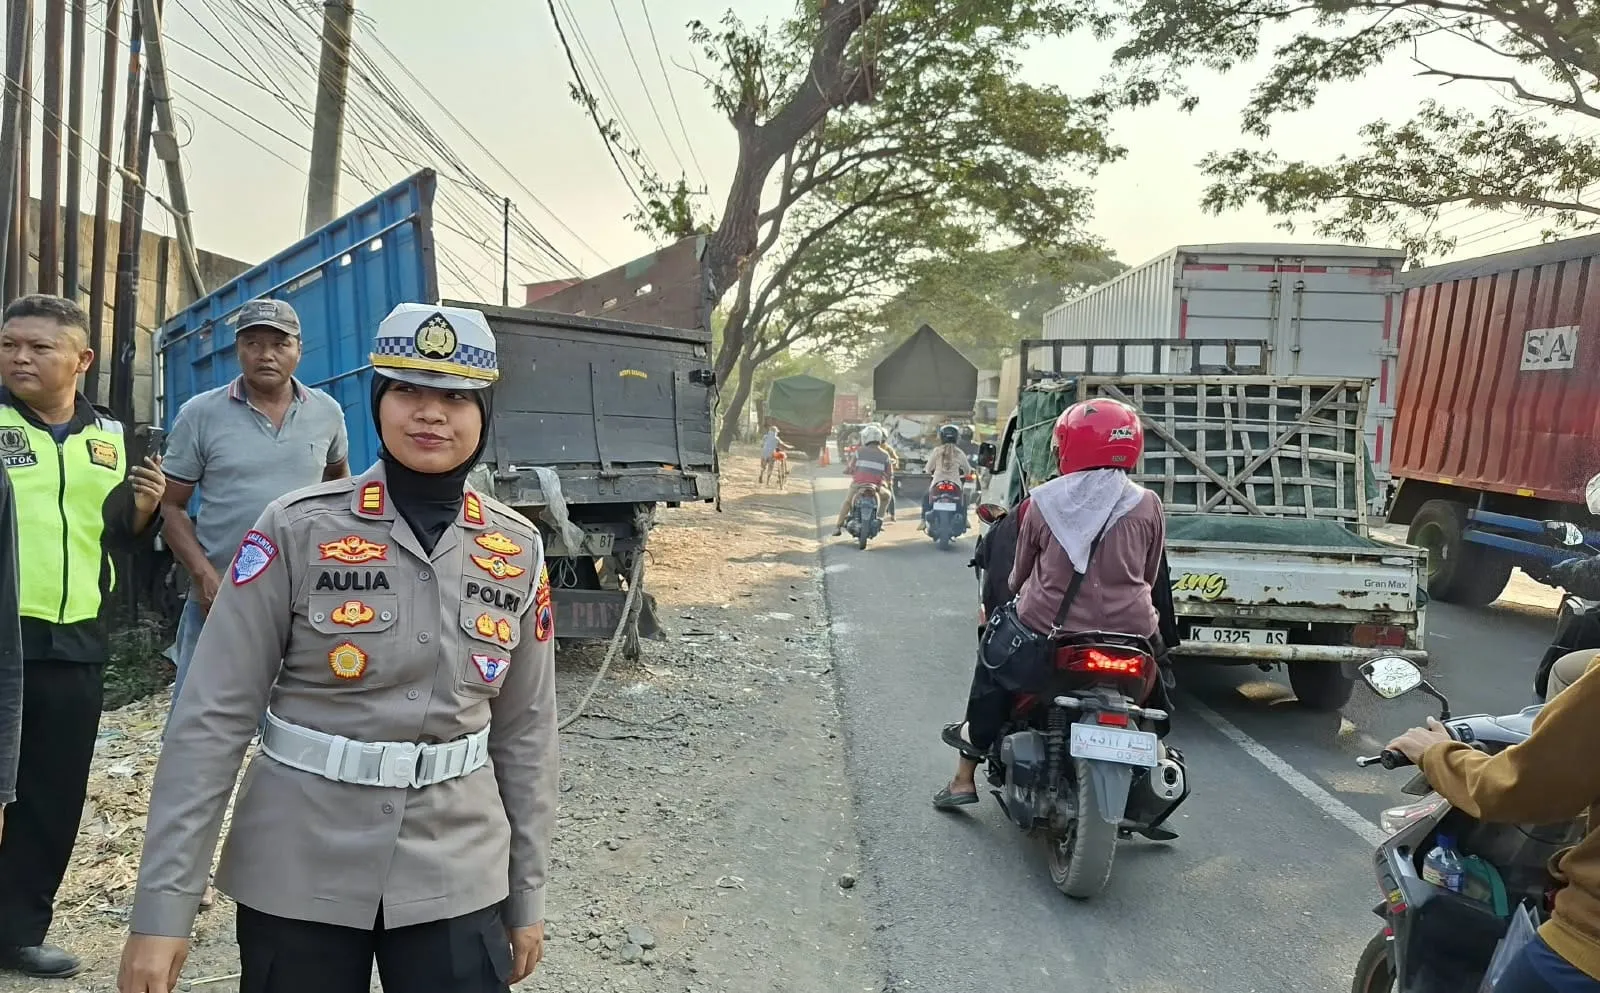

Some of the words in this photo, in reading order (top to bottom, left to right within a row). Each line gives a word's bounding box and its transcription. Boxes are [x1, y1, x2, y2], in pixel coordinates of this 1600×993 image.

[315, 571, 390, 590] AULIA
[1364, 579, 1386, 588] Gran
[1388, 580, 1407, 589] Max
[466, 581, 520, 612] POLRI
[1192, 628, 1201, 641] K
[1213, 629, 1250, 643] 9325
[1265, 632, 1284, 645] AS
